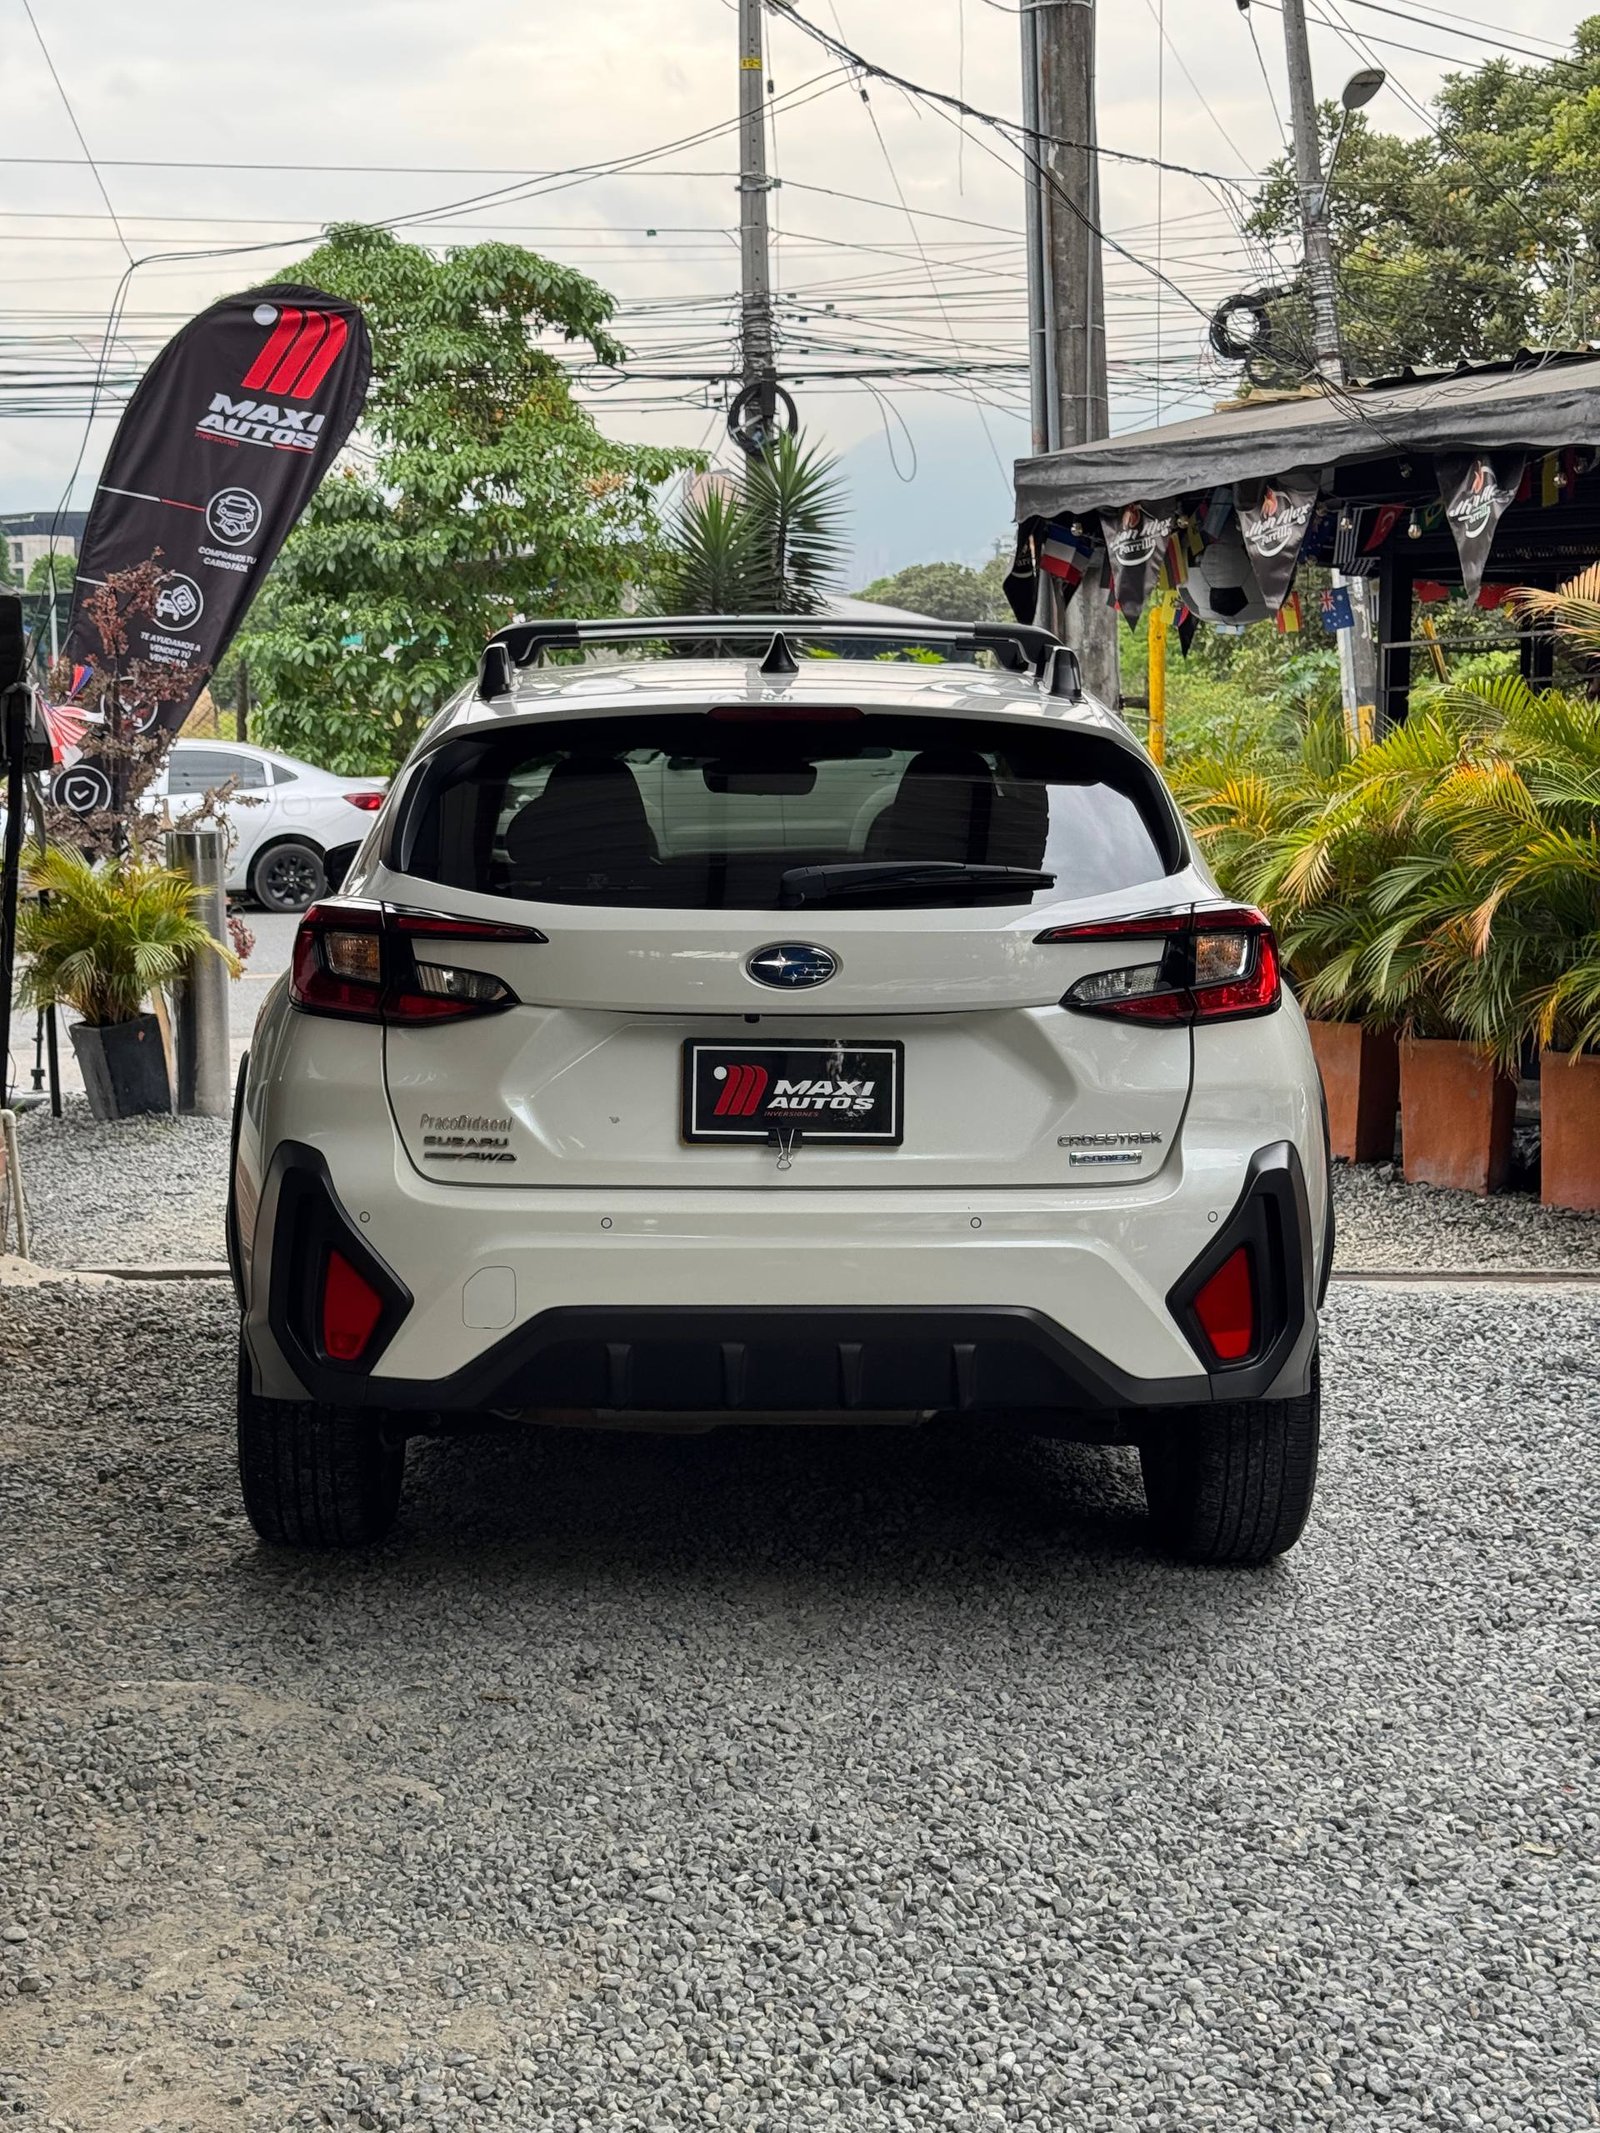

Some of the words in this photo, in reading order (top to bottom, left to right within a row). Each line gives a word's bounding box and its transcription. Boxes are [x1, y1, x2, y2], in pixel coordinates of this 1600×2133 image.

[208, 392, 325, 433] MAXI
[197, 413, 319, 450] AUTOS
[140, 631, 150, 641] TE
[149, 634, 195, 651] AYUDAMOS
[194, 644, 201, 653] A
[149, 643, 180, 657] VENDER
[772, 1079, 876, 1096] MAXI
[766, 1096, 876, 1110] AUTOS
[763, 1110, 820, 1118] INVERSIONES
[423, 1136, 509, 1149] SUBARU
[1057, 1131, 1163, 1147] CROSSTREK
[463, 1152, 517, 1162] AWD
